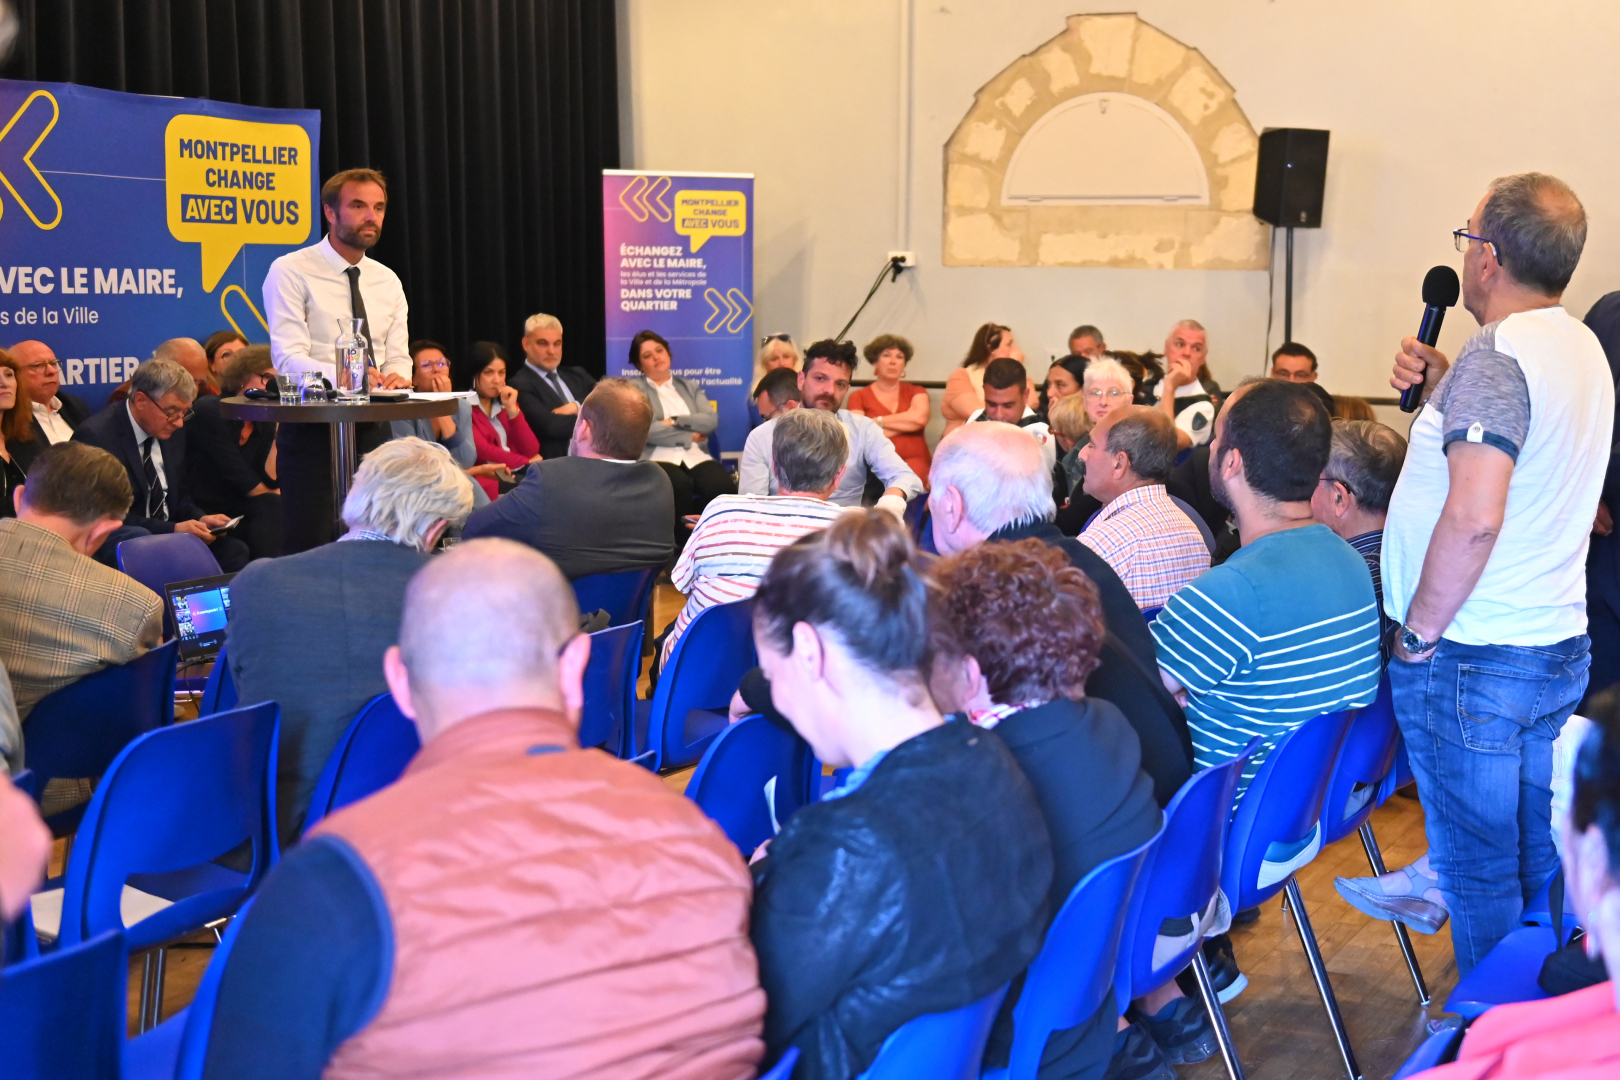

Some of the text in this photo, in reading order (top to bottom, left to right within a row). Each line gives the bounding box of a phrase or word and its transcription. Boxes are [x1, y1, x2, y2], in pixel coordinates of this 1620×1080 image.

[179, 138, 298, 166] MONTPELLIER
[205, 167, 276, 191] CHANGE
[681, 198, 740, 207] MONTPELLIER
[185, 197, 299, 226] AVEC VOUS
[693, 208, 728, 216] CHANGE
[683, 218, 740, 229] AVEC VOUS
[620, 243, 682, 256] ÉCHANGEZ
[620, 257, 707, 270] AVEC LE MAIRE,
[620, 270, 631, 278] les
[647, 270, 655, 278] et
[656, 270, 666, 278] les
[667, 270, 696, 278] services
[697, 270, 707, 278] de
[0, 266, 184, 299] VEC LE MAIRE,
[672, 279, 707, 287] Métropole
[620, 288, 692, 299] DANS VOTRE
[620, 300, 678, 312] QUARTIER
[14, 306, 38, 325] de
[42, 306, 59, 325] la
[63, 306, 99, 325] Ville
[684, 368, 703, 377] pour
[704, 366, 721, 375] être
